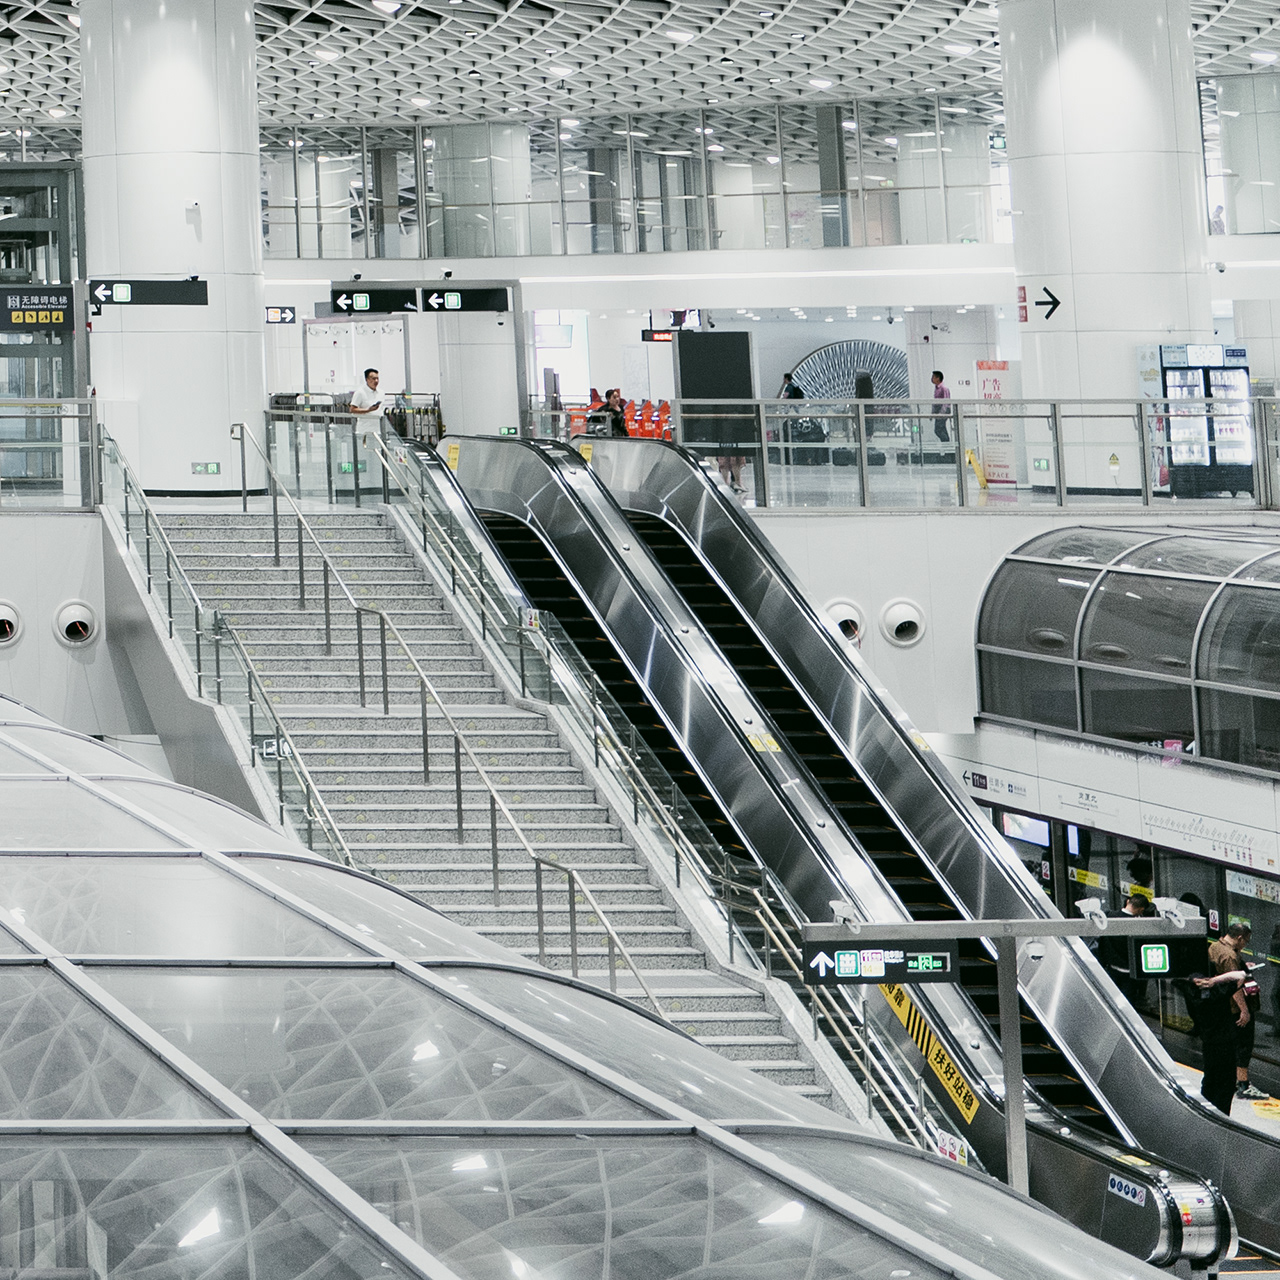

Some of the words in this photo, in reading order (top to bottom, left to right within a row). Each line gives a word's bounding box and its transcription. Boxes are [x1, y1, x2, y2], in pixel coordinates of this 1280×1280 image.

[21, 295, 68, 305] 无障碍电梯
[934, 1048, 974, 1110] 扶好站稳
